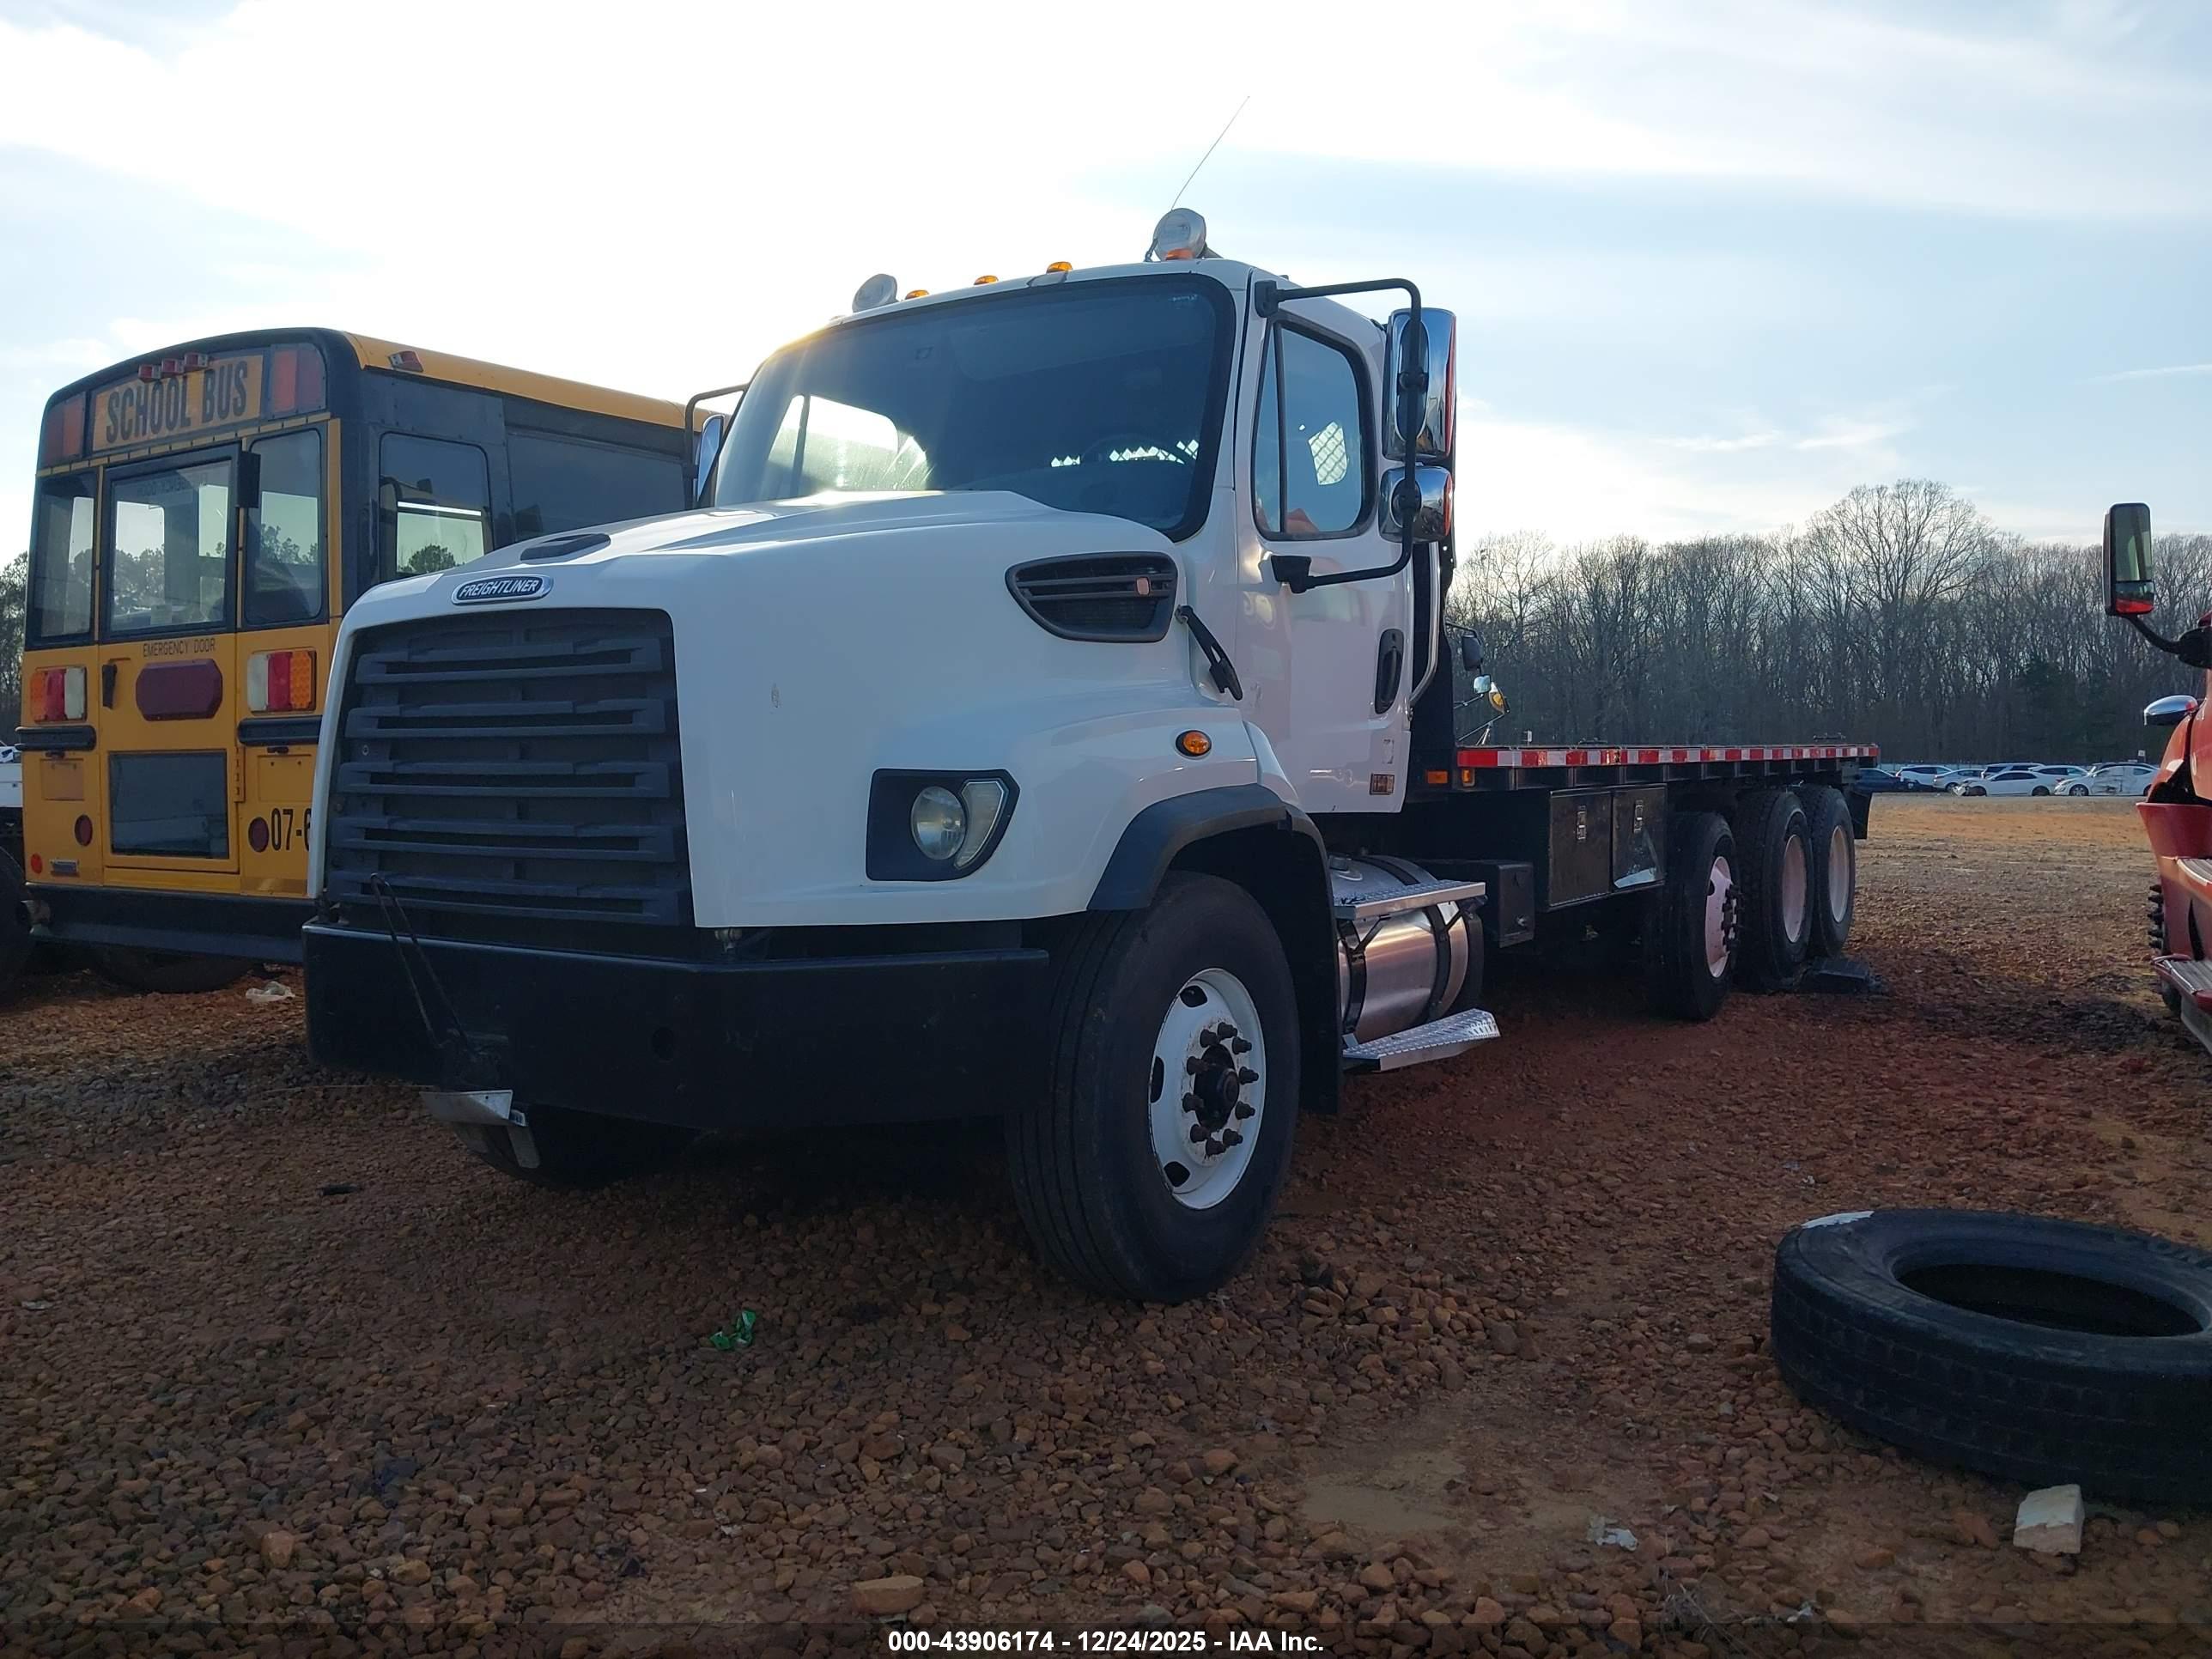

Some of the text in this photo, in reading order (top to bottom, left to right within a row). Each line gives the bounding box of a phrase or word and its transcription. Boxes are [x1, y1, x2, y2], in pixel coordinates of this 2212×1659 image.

[106, 361, 248, 444] SCHOOL BUS
[459, 580, 539, 598] FREIGHTLINER
[143, 637, 216, 658] EMERGENCY DOOR
